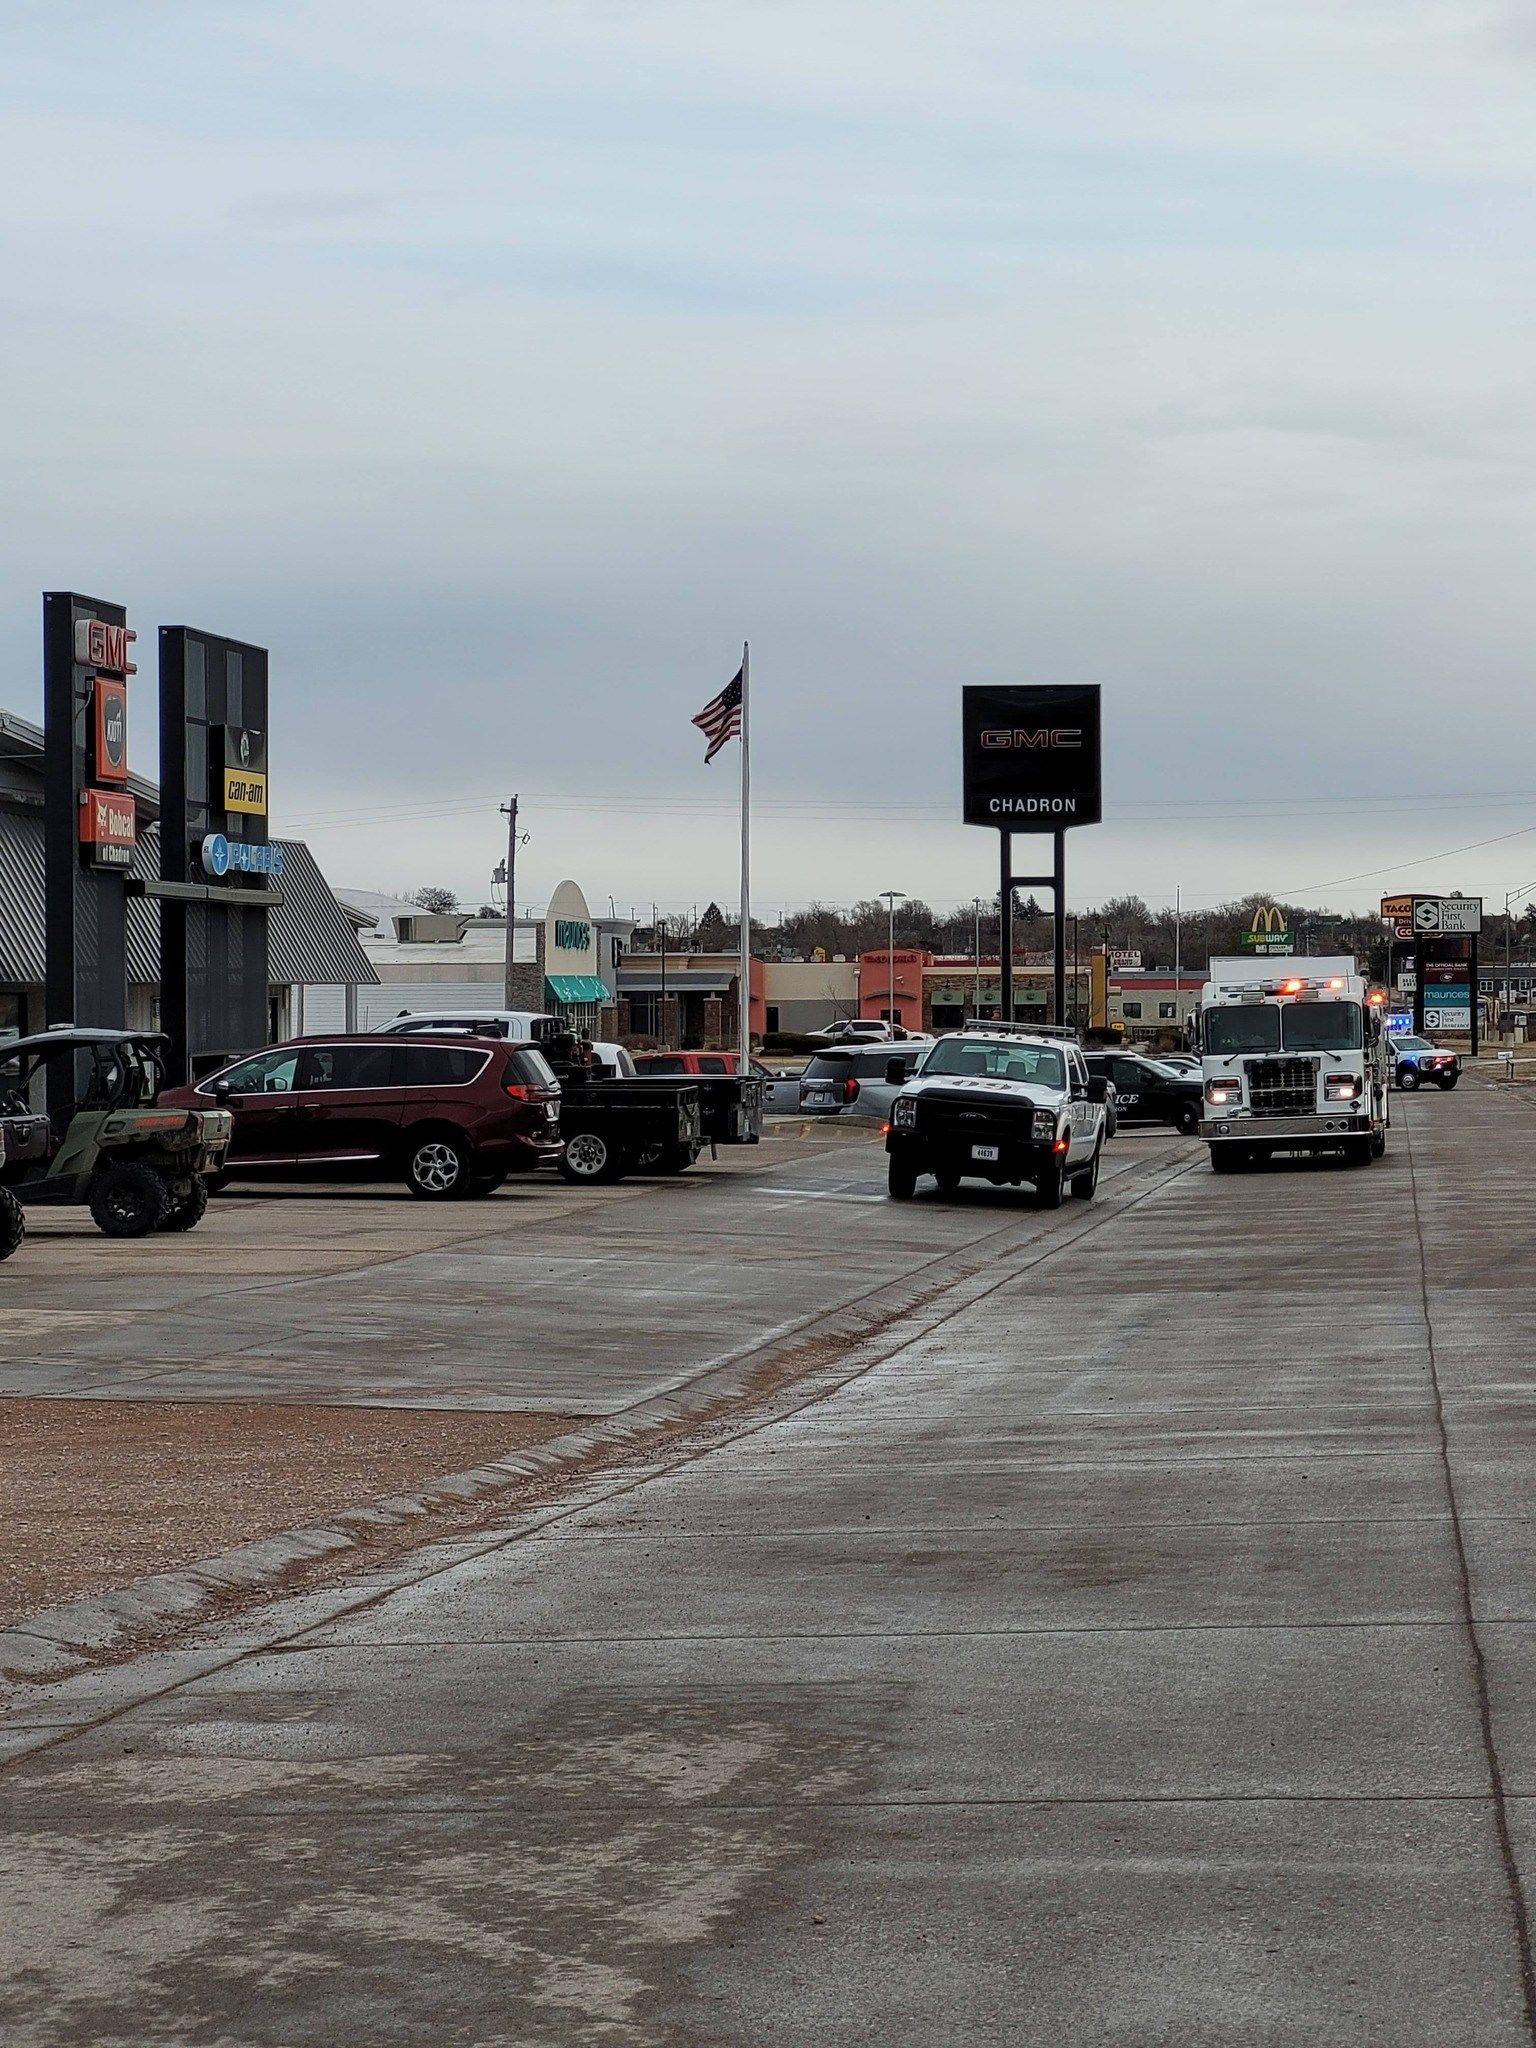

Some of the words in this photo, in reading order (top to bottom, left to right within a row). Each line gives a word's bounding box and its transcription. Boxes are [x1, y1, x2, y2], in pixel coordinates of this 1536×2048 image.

[86, 619, 138, 675] GMC
[980, 729, 1082, 749] GMC
[228, 780, 264, 804] can-am
[989, 798, 1076, 813] CHADRON
[108, 808, 134, 838] Bobcat
[229, 842, 284, 875] POLARIS
[1384, 904, 1411, 913] TACO
[1440, 900, 1480, 914] Security
[1441, 910, 1461, 921] First
[1441, 920, 1467, 930] Bank
[1247, 934, 1289, 943] SUBWAY
[1441, 1010, 1465, 1018] Security
[1114, 1094, 1140, 1104] ICE
